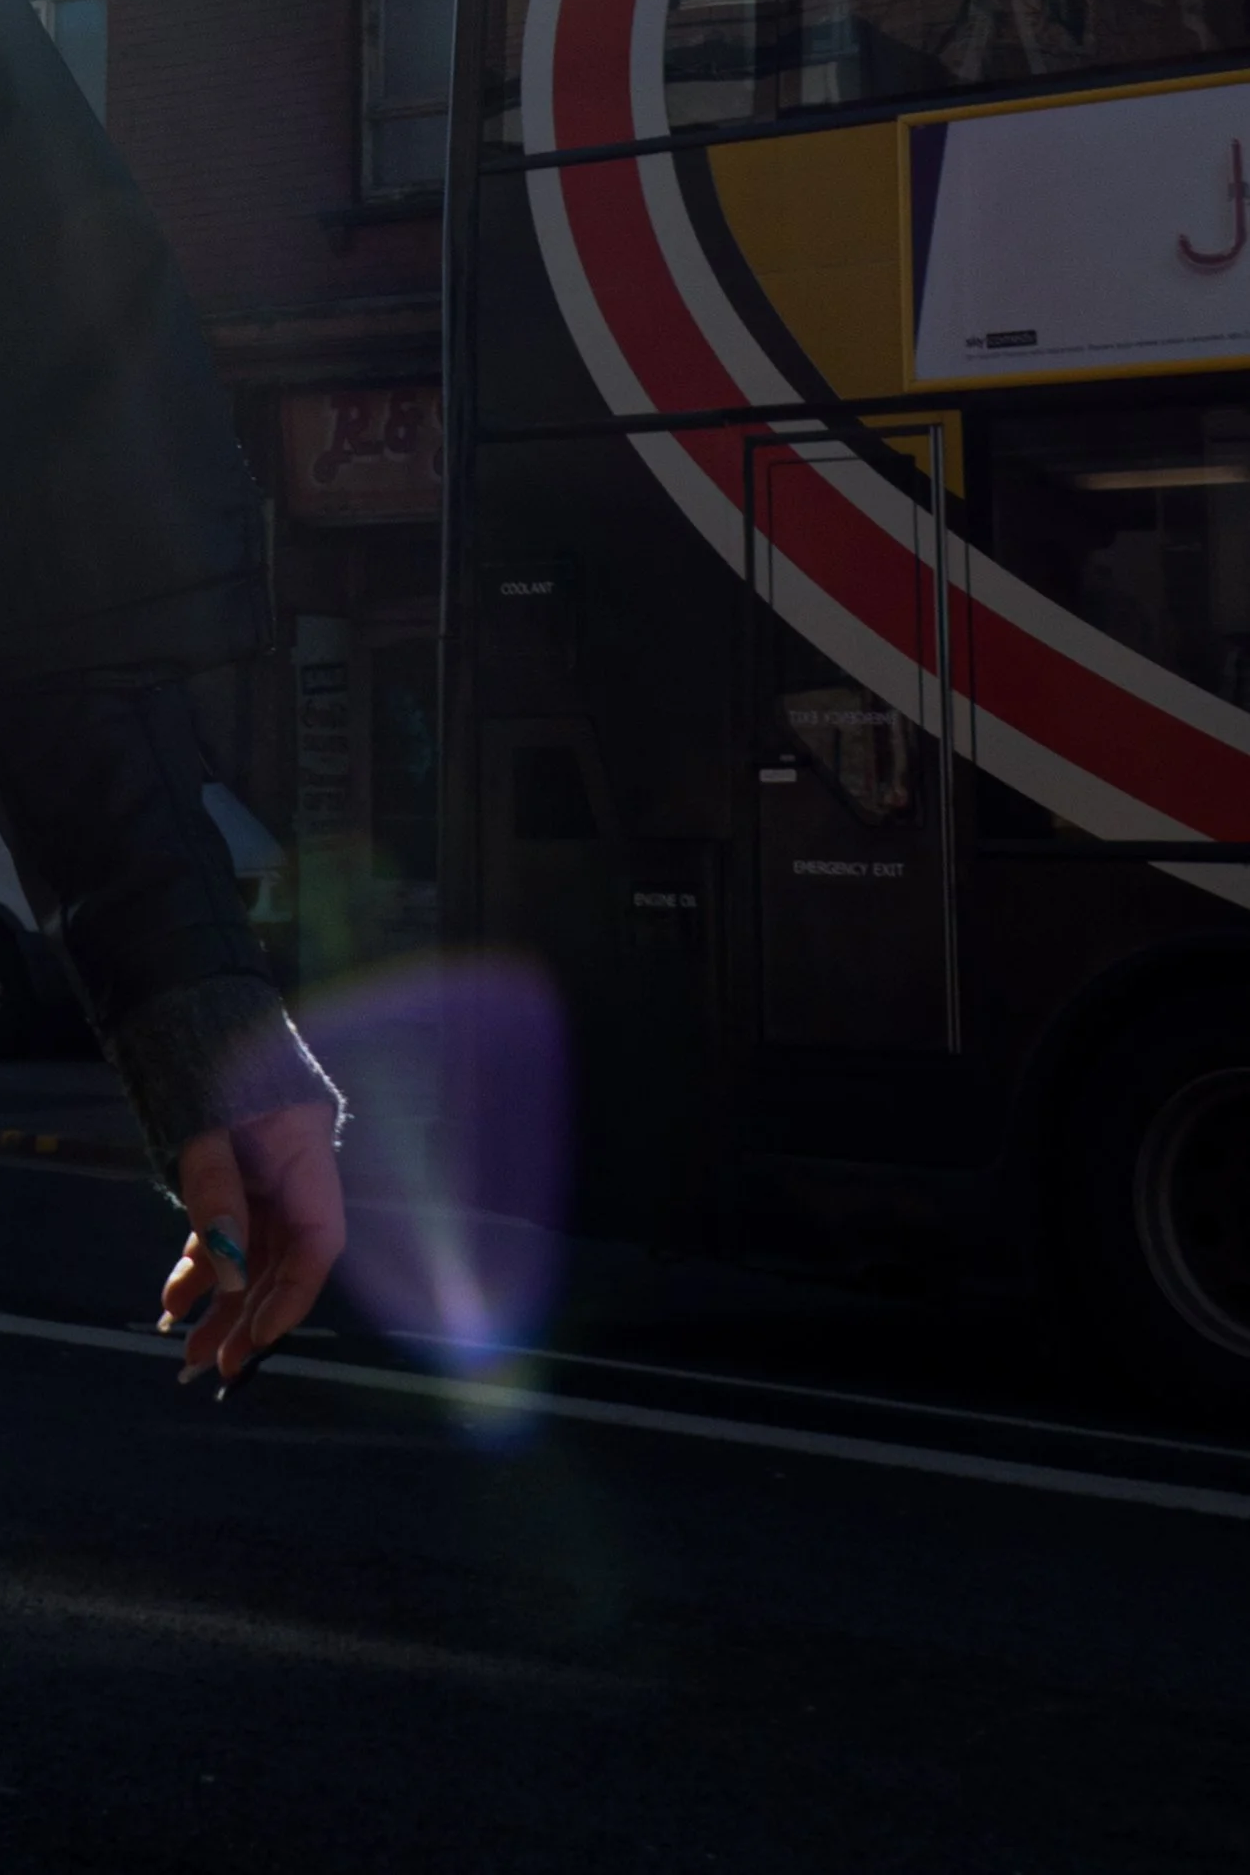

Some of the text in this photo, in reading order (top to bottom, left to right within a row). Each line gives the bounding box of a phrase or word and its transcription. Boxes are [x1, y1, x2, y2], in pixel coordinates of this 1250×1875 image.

[501, 581, 554, 596] COOLANT
[793, 860, 905, 878] EMERGENCY EXIT
[634, 892, 697, 907] ENGINE OIL
